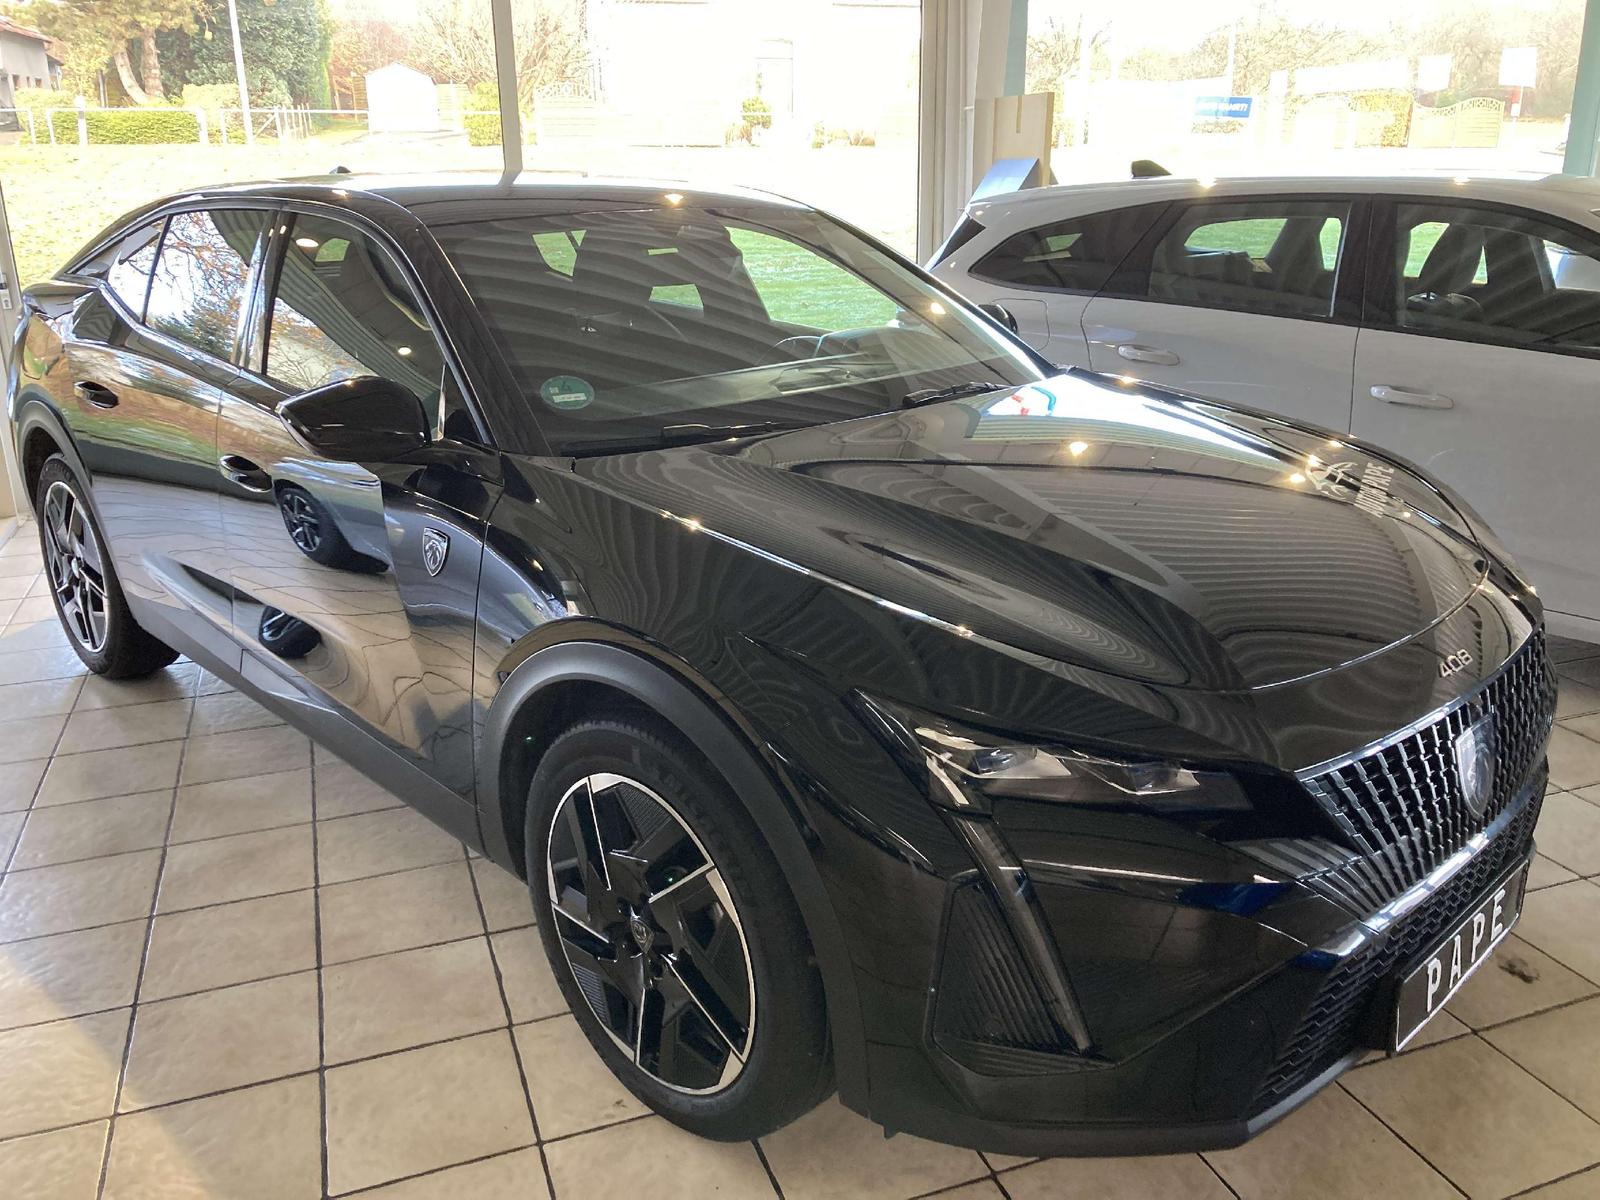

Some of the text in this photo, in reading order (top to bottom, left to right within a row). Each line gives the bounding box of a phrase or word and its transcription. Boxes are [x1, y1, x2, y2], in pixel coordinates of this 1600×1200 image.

[1361, 462, 1395, 491] PAPE
[1440, 649, 1473, 677] 408
[1427, 888, 1506, 1013] PAPE
